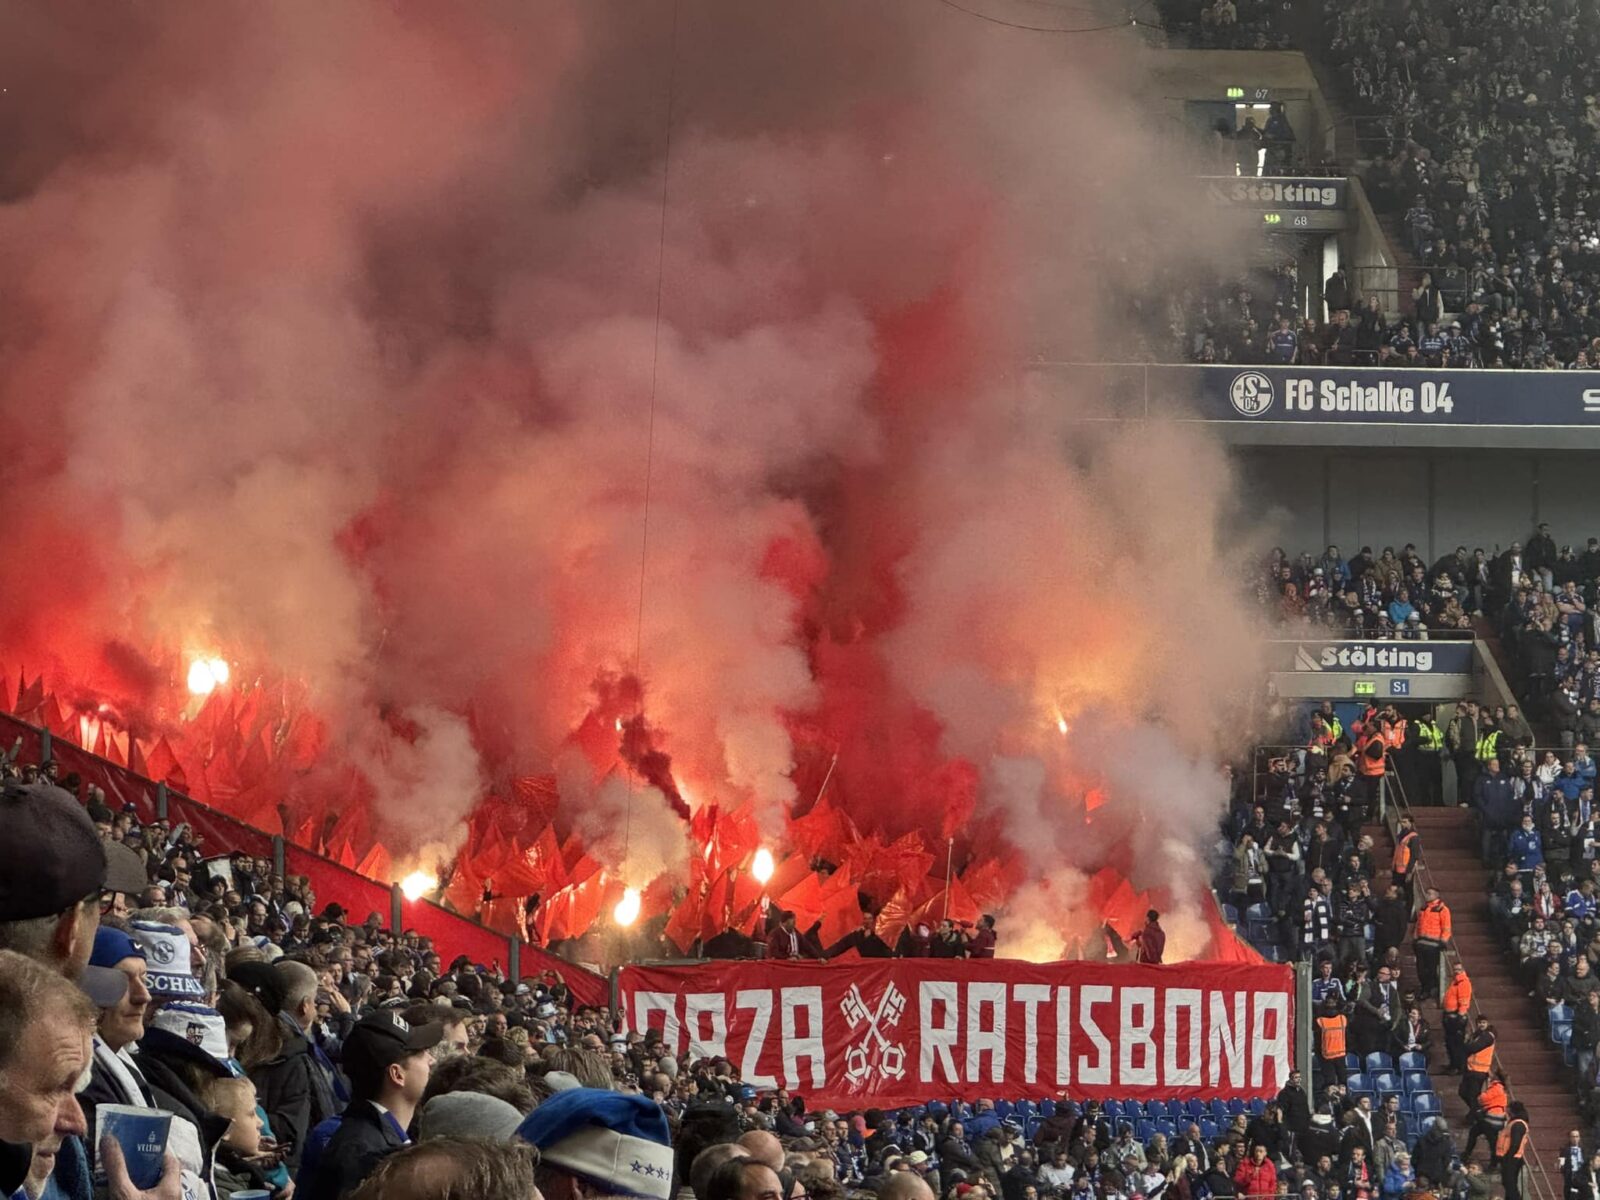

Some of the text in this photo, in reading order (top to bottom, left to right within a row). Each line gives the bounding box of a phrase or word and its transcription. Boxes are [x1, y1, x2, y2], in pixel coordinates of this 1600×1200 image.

[1255, 89, 1269, 99] 67
[1231, 182, 1337, 206] Stölting
[1294, 216, 1308, 226] 68
[1285, 379, 1454, 414] FC Schalke 04
[1321, 645, 1433, 671] Stölting
[1393, 681, 1407, 693] S1
[620, 980, 1291, 1091] ORZA RATISBONA
